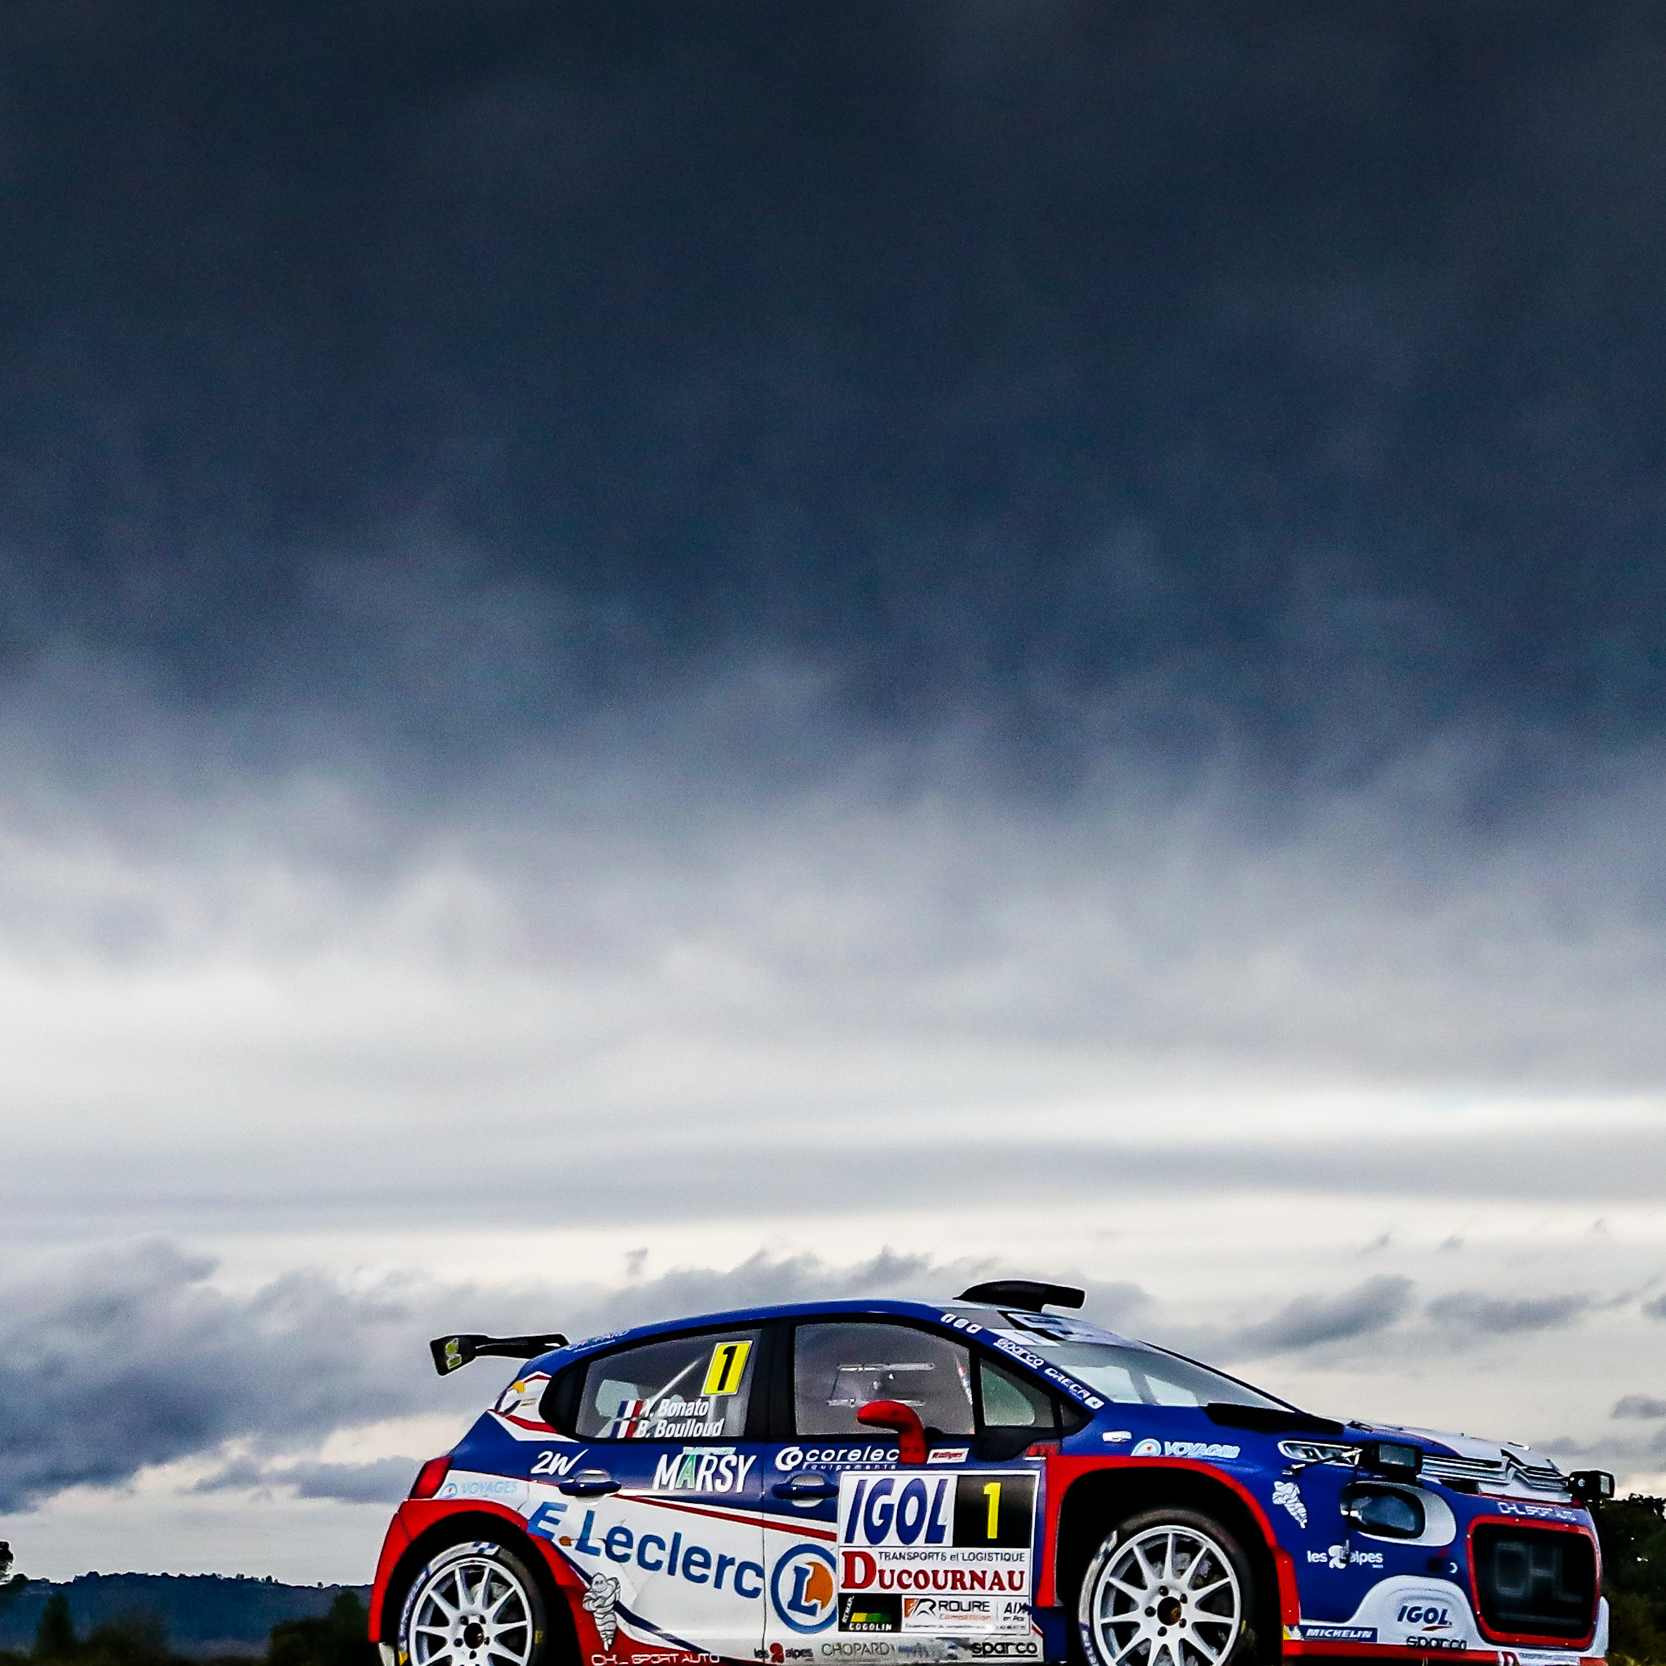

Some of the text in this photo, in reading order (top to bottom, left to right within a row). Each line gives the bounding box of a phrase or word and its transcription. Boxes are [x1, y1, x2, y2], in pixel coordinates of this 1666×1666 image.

[994, 1338, 1045, 1368] sparco
[722, 1345, 738, 1391] 1
[657, 1398, 709, 1417] Bonato
[637, 1417, 725, 1438] B. Boulloud
[805, 1446, 900, 1462] corelec
[653, 1454, 757, 1494] MARSY
[461, 1480, 519, 1495] VOYAGES
[844, 1477, 949, 1546] IGOL
[983, 1481, 1002, 1540] 1
[878, 1551, 947, 1562] TRANSPORTS
[962, 1552, 1026, 1563] LOGISTIQUE
[1307, 1550, 1328, 1563] les
[938, 1600, 991, 1613] ROURE
[1397, 1605, 1451, 1625] IGOL
[849, 1622, 892, 1631] COGOLIN
[1306, 1628, 1374, 1639] MICHELIN
[821, 1642, 891, 1657] CHOPARD
[971, 1642, 1039, 1657] sparco
[631, 1653, 679, 1665] SPORT
[681, 1652, 720, 1664] AUTO
